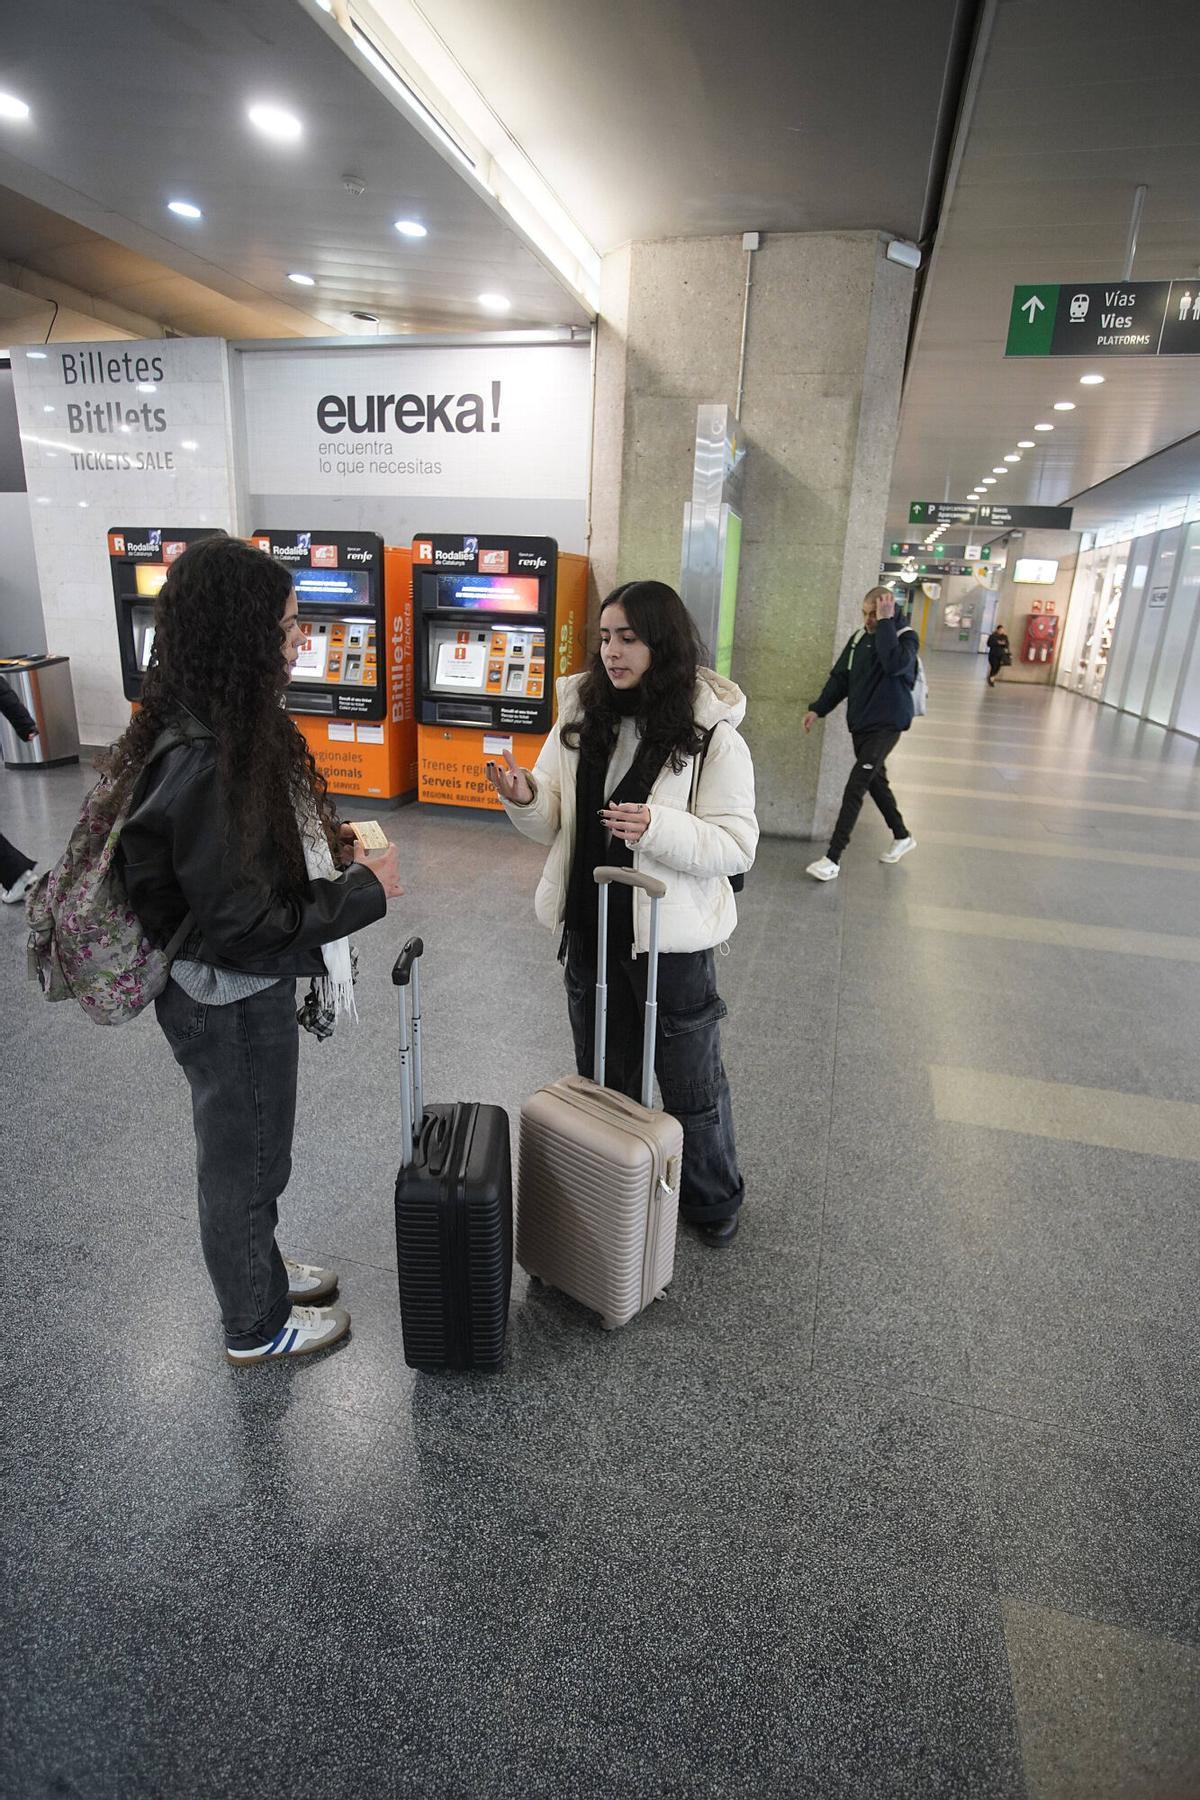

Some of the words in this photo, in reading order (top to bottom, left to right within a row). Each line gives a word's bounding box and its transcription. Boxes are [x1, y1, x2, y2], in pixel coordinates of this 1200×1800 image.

[1105, 290, 1136, 307] Vías
[1101, 313, 1132, 329] Vies
[1097, 334, 1151, 346] PLATFORMS
[61, 351, 164, 385] Billetes
[317, 381, 501, 434] eureka!
[67, 400, 168, 434] Bitllets
[318, 442, 393, 456] encuentra
[71, 452, 131, 471] TICKETS
[136, 451, 175, 470] SALE
[319, 458, 332, 474] lo
[336, 461, 365, 477] que
[369, 458, 442, 474] necesitas
[113, 537, 125, 551] R
[127, 542, 160, 552] Rodalies
[272, 545, 309, 556] Rodalies
[419, 543, 433, 560] R
[435, 549, 475, 561] Rodalies
[347, 551, 373, 563] renfe
[518, 556, 547, 570] renfe
[403, 602, 412, 658] Tickets
[391, 615, 404, 723] Bitllets
[422, 758, 458, 772] Trenes
[422, 775, 461, 789] Serveis
[422, 790, 453, 801] REGIONAL
